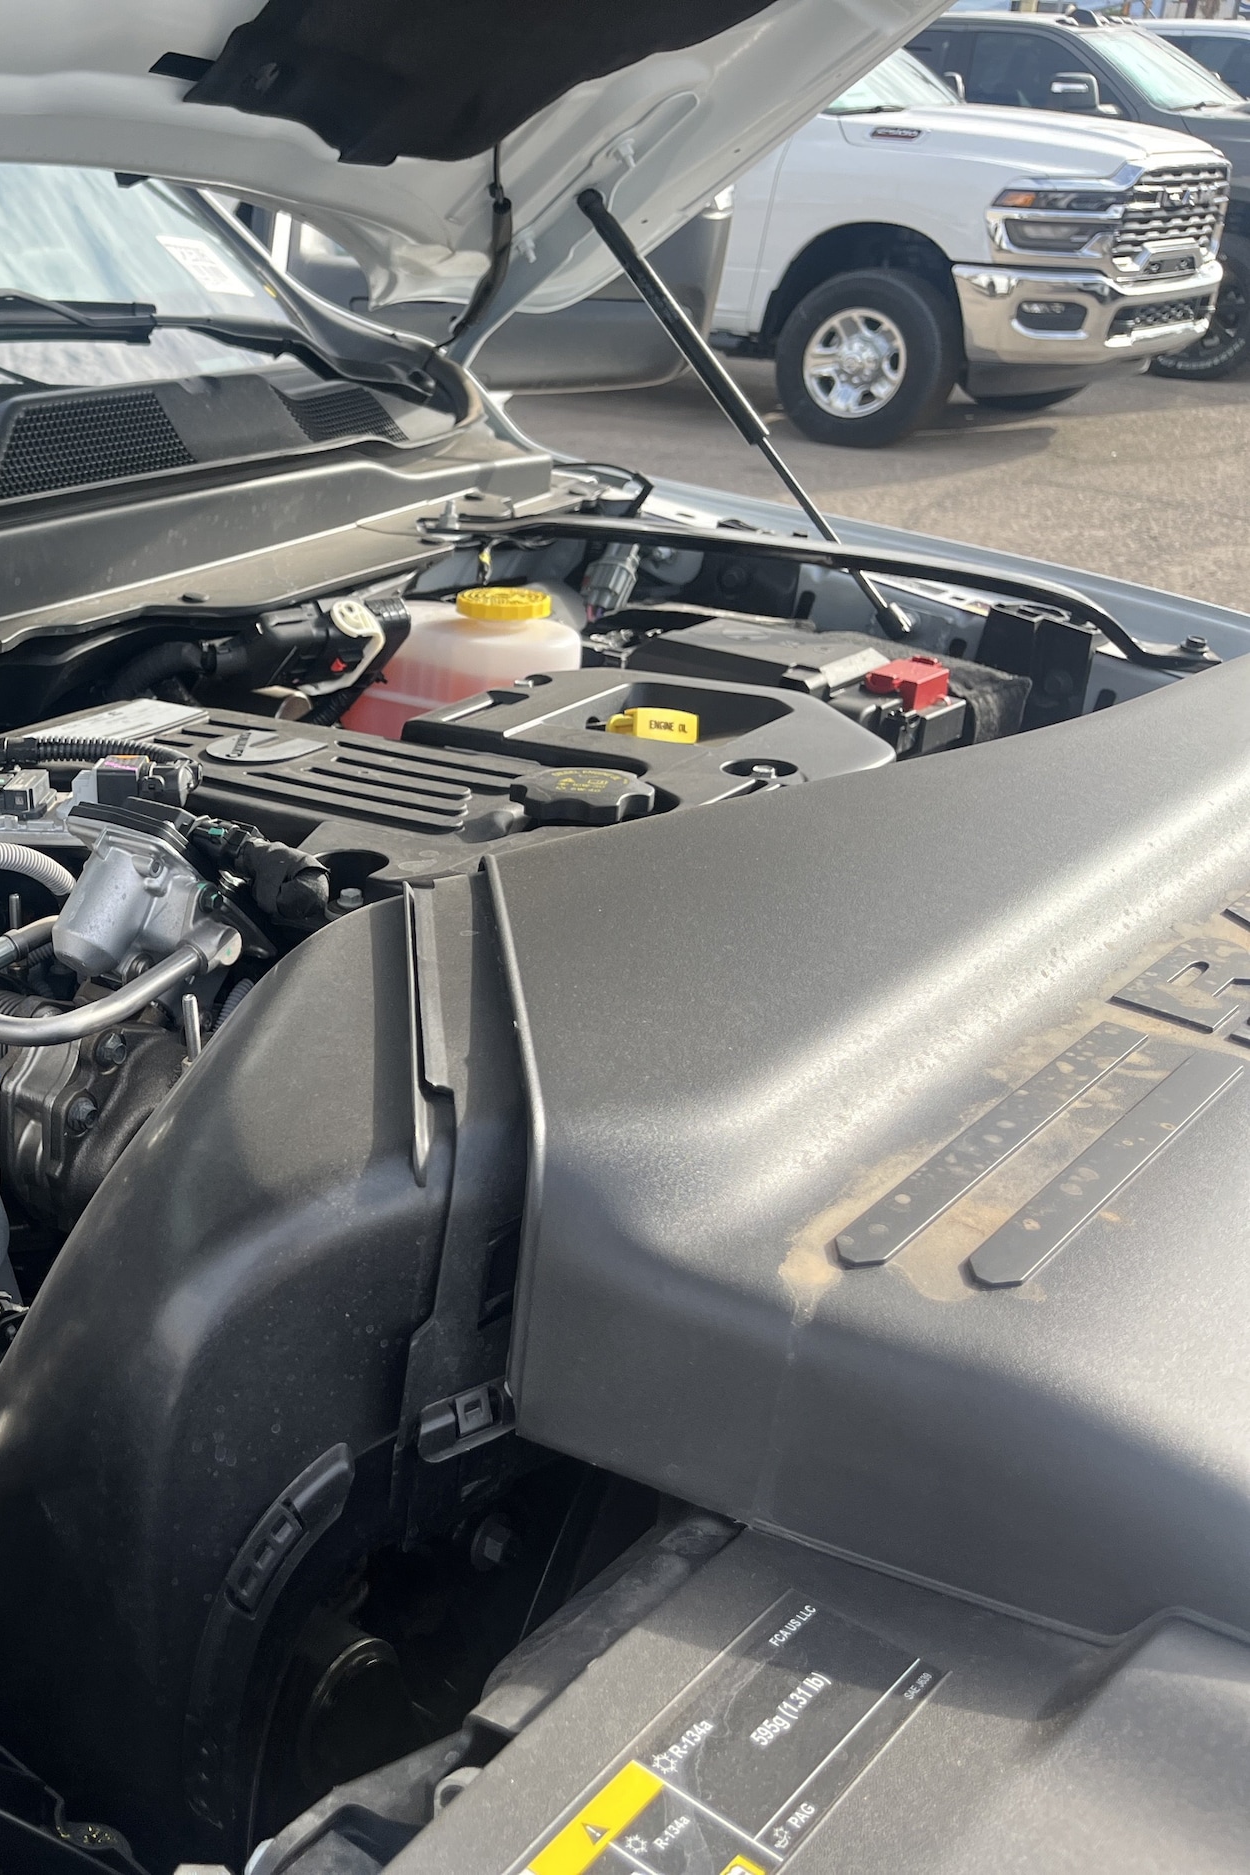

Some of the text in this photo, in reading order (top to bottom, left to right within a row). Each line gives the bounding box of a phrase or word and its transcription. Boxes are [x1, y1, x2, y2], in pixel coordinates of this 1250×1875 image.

[649, 719, 675, 732] ENGINE
[768, 1604, 817, 1647] FCA US LLC
[749, 1671, 832, 1746] 595g (1.31 lb)
[903, 1684, 922, 1700] SAE
[668, 1720, 714, 1759] R-134a
[653, 1816, 691, 1850] R-134a
[787, 1803, 815, 1829] PAG
